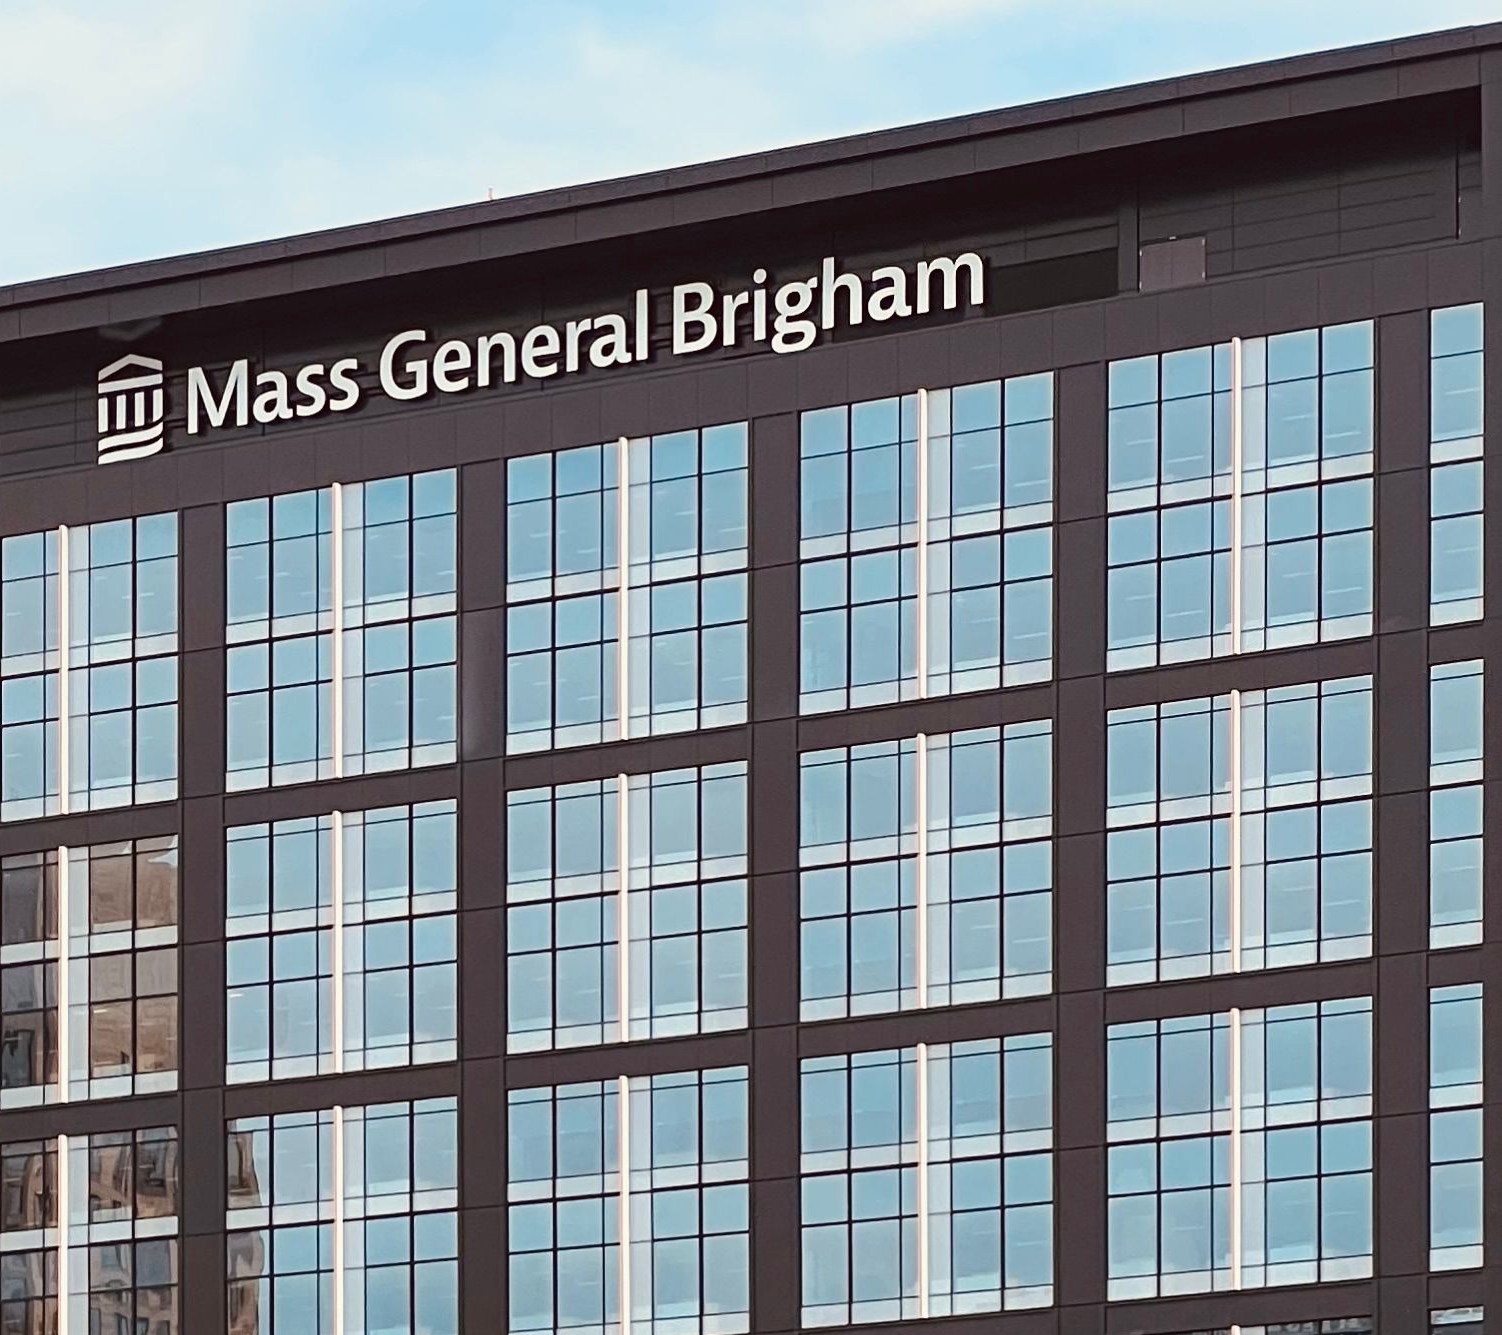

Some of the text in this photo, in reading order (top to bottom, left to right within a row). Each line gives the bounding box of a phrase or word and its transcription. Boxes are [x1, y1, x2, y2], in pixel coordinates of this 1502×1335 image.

[186, 252, 985, 435] Mass General Brigham
